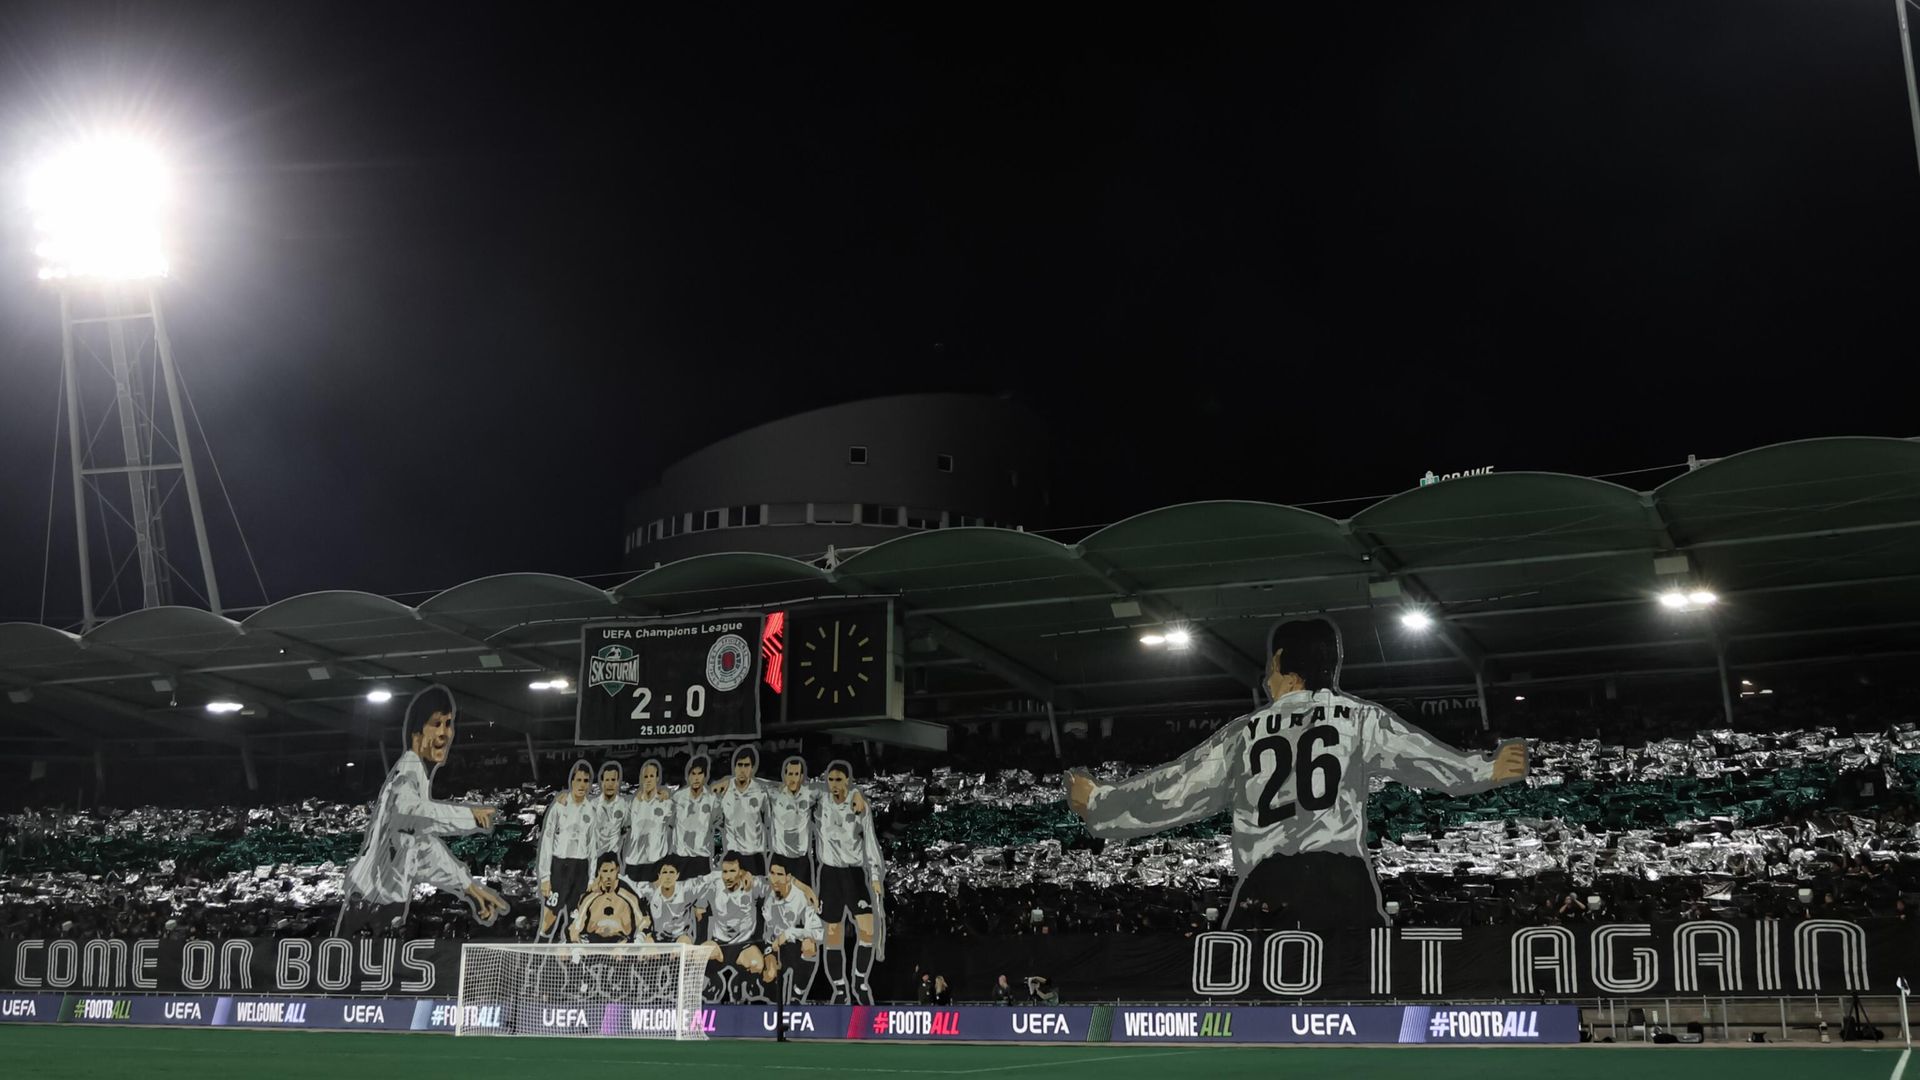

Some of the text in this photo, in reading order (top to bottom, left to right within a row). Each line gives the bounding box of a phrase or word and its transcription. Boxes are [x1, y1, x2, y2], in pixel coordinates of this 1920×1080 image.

[602, 621, 743, 639] UEFA Champions League
[591, 660, 637, 682] SK STURM
[640, 724, 694, 736] 25.10.2000
[1248, 705, 1350, 739] YURAN
[1249, 724, 1342, 827] 26
[15, 938, 436, 991] COME ON BOYS
[1192, 919, 1870, 995] DO IT AGAIN
[2, 999, 36, 1016] UEFA
[73, 999, 132, 1018] #FOOTBALL
[164, 1002, 201, 1018] UEFA
[236, 1002, 307, 1023] WELCOME ALL
[343, 1005, 384, 1023] UEFA
[431, 1005, 501, 1026] #FOTBALL
[543, 1008, 588, 1027] UEFA
[690, 1009, 716, 1031] ALL
[873, 1011, 960, 1035] #FOOTBALL
[1012, 1013, 1070, 1034] UEFA
[1124, 1012, 1233, 1037] WELCOME ALL
[1291, 1013, 1356, 1035] UEFA
[1429, 1011, 1539, 1037] #FOOTBALL
